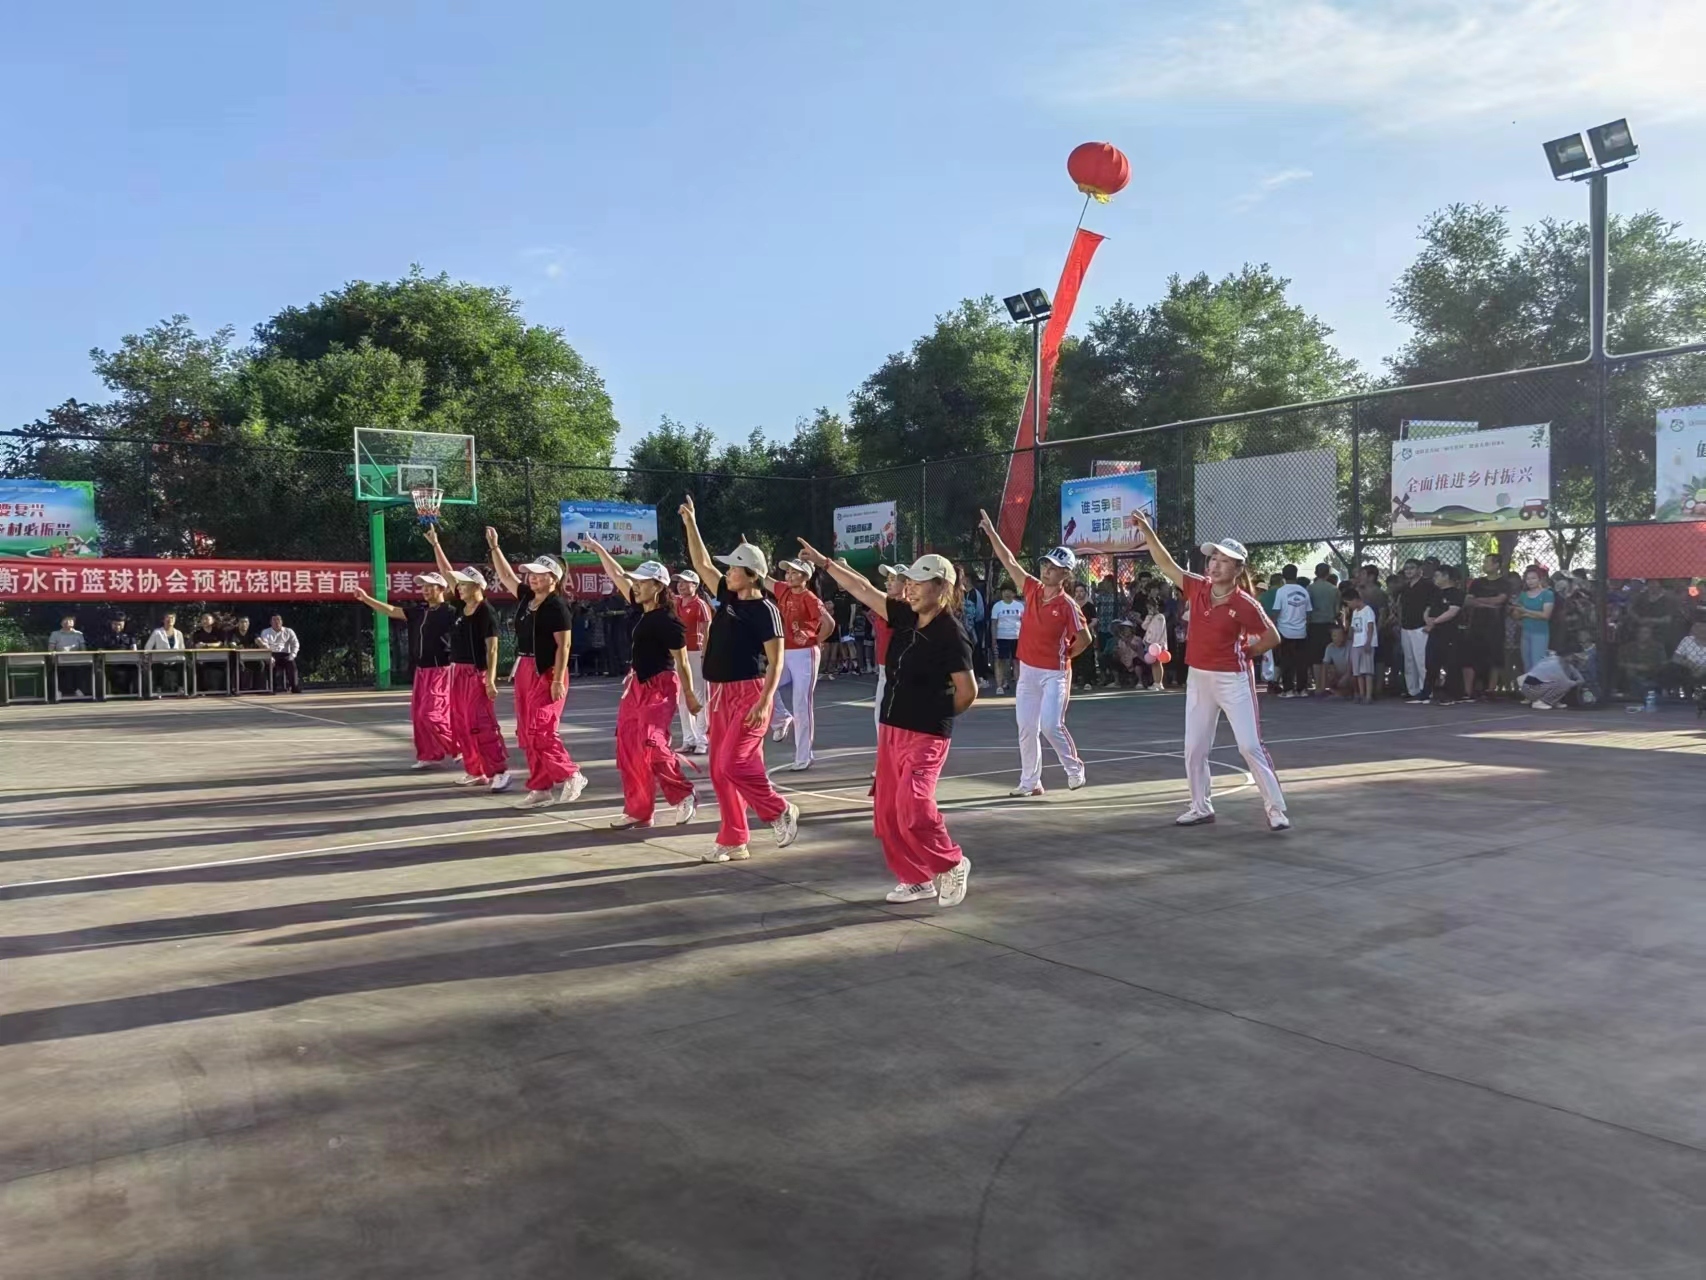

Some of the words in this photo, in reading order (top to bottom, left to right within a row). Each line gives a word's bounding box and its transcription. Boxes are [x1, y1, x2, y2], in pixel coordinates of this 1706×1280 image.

[1406, 466, 1533, 493] 全面推进乡村振兴
